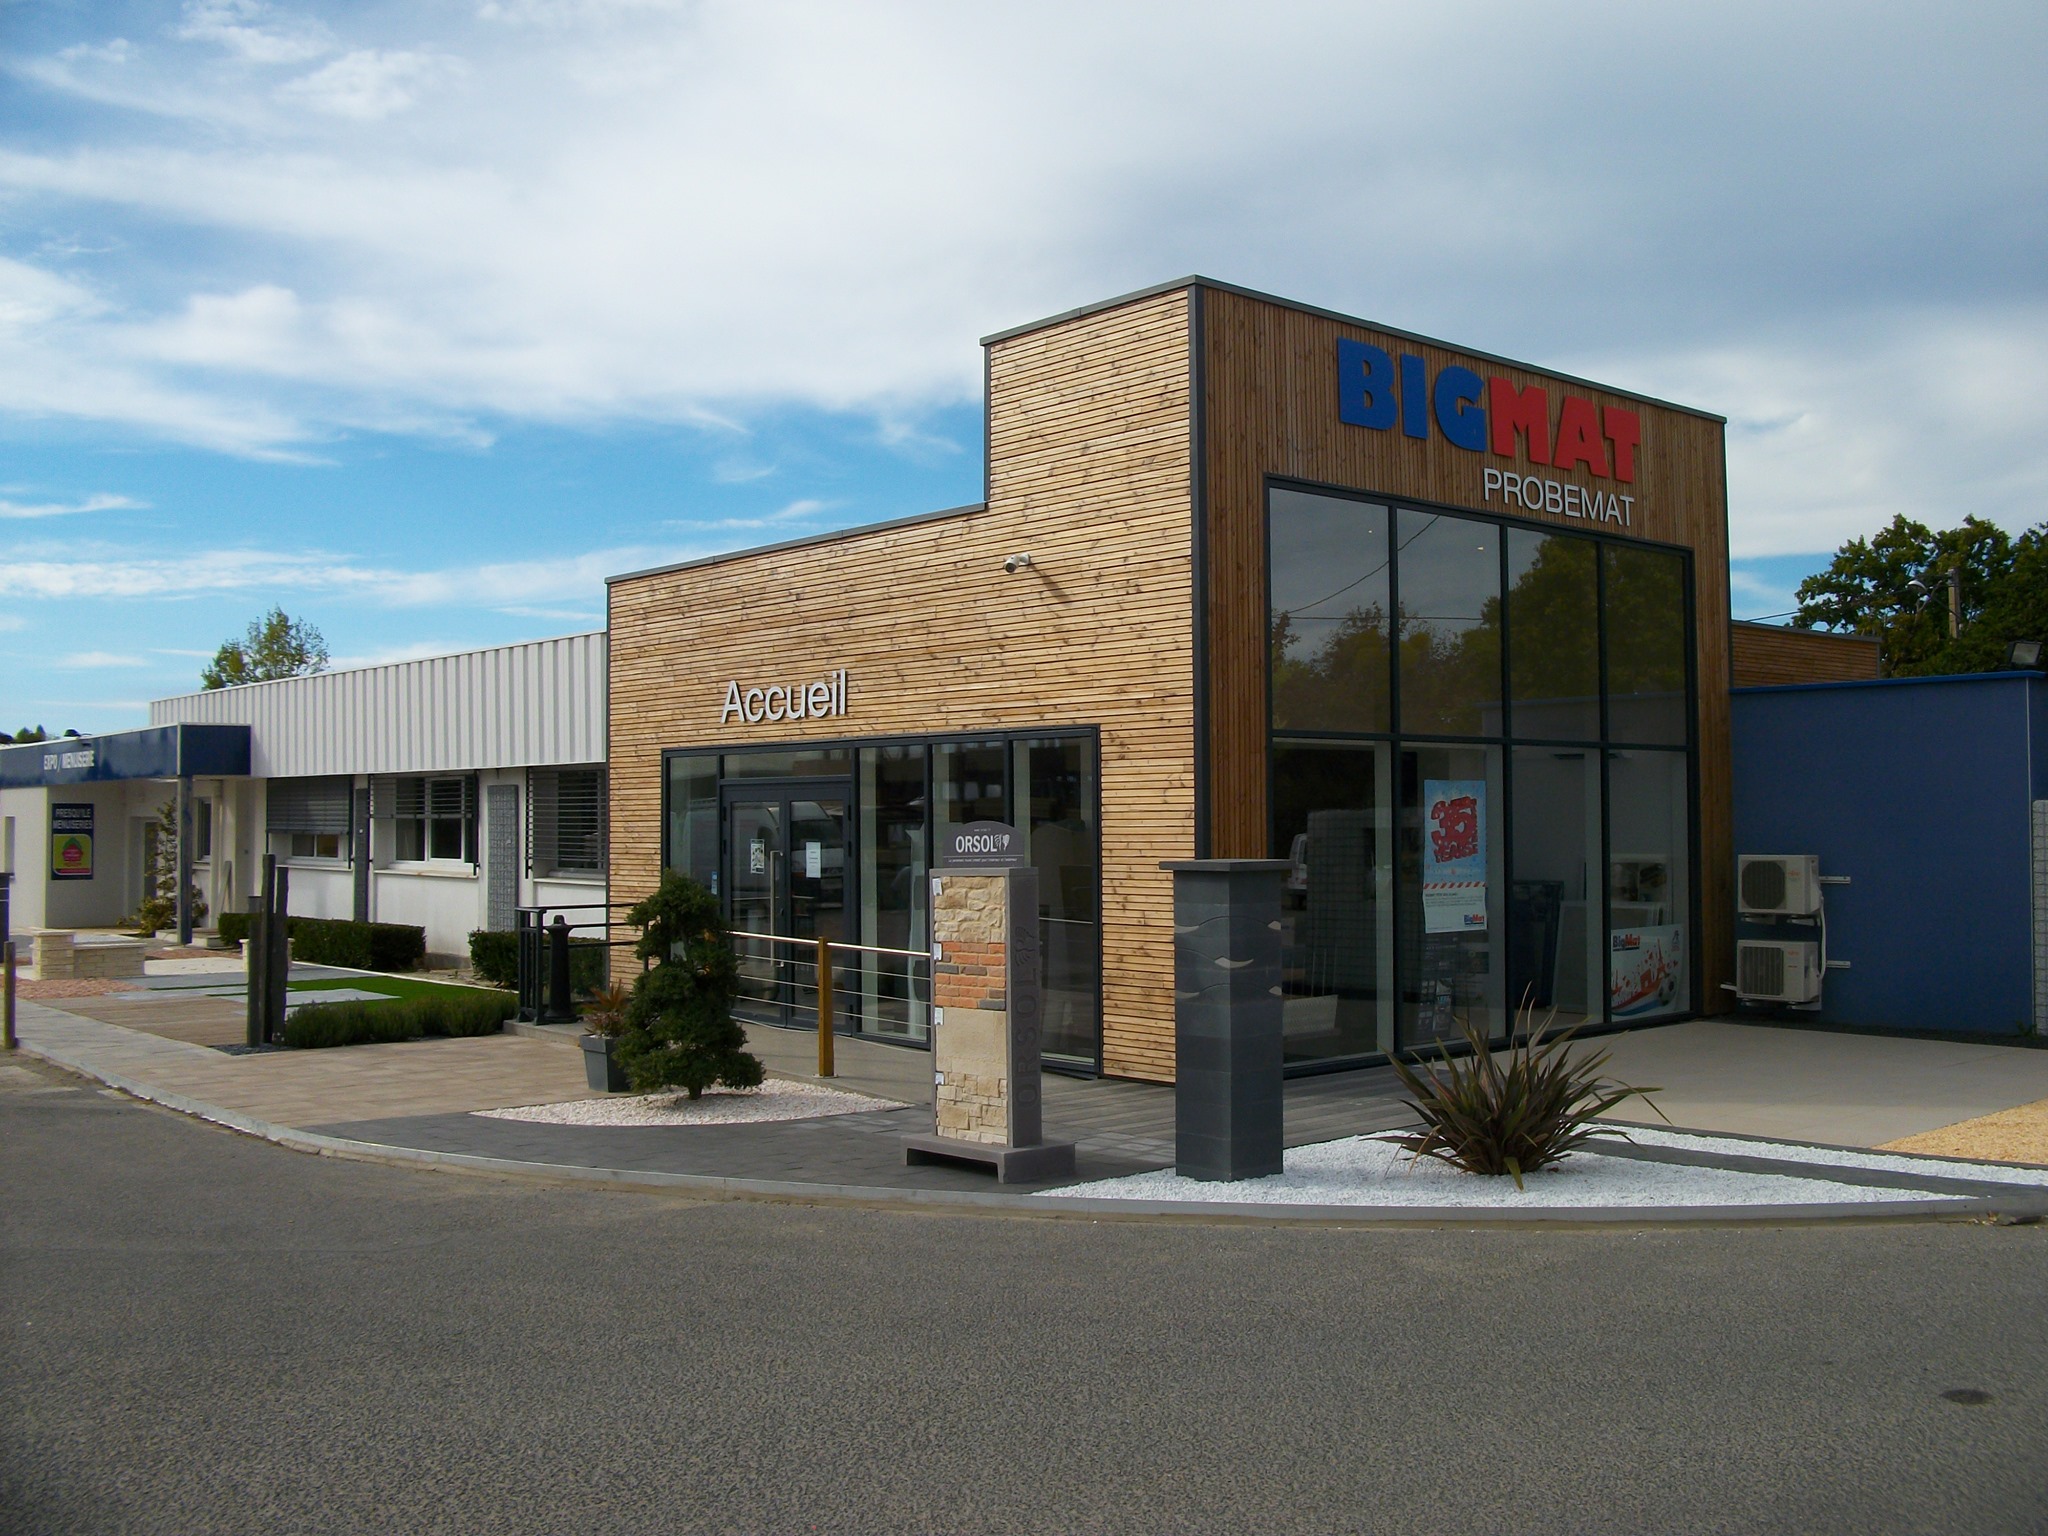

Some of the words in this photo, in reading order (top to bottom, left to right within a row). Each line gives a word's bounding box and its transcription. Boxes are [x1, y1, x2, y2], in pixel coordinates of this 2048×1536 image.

[1337, 337, 1641, 483] BIGMAT
[1483, 467, 1635, 527] PROBEMAT
[721, 668, 849, 724] Accueil
[955, 834, 998, 853] ORSOL
[1612, 934, 1641, 949] BigMat
[1015, 967, 1038, 1109] ORSOL
